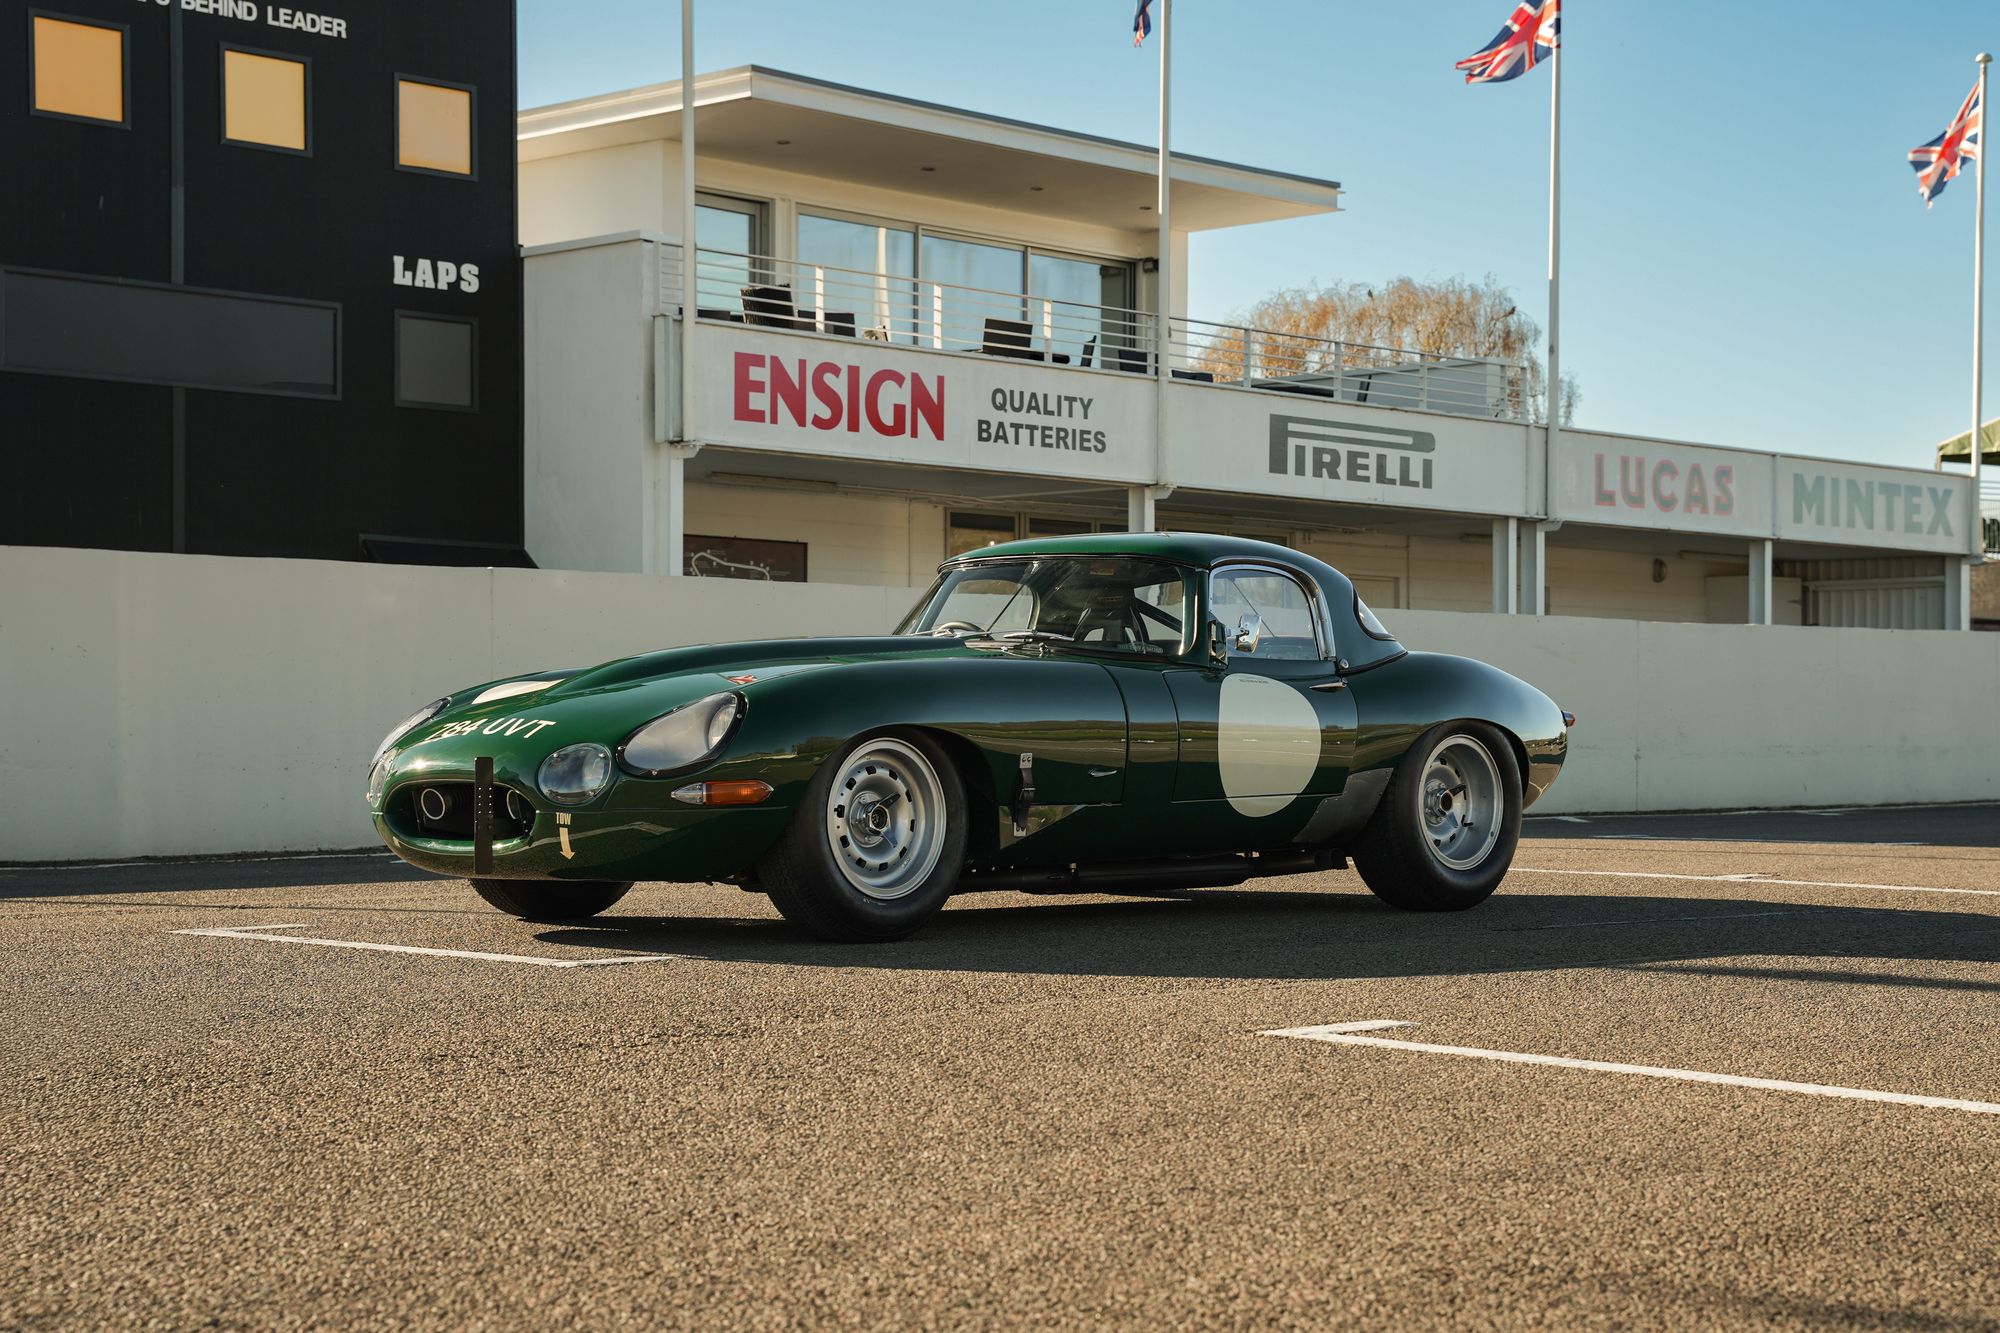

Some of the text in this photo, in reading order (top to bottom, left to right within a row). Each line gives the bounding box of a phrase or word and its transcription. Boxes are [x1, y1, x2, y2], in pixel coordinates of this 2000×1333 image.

[267, 6, 347, 39] LEADER
[393, 255, 480, 293] LAPS
[734, 352, 945, 441] ENSIGN
[991, 388, 1093, 420] QUALITY
[977, 419, 1107, 453] BATTERIES
[1269, 413, 1436, 489] PIRELLI
[1594, 453, 1734, 516] LUCAS
[1793, 473, 1954, 537] MINTEX
[482, 718, 557, 739] UVT
[555, 811, 572, 826] TOW
